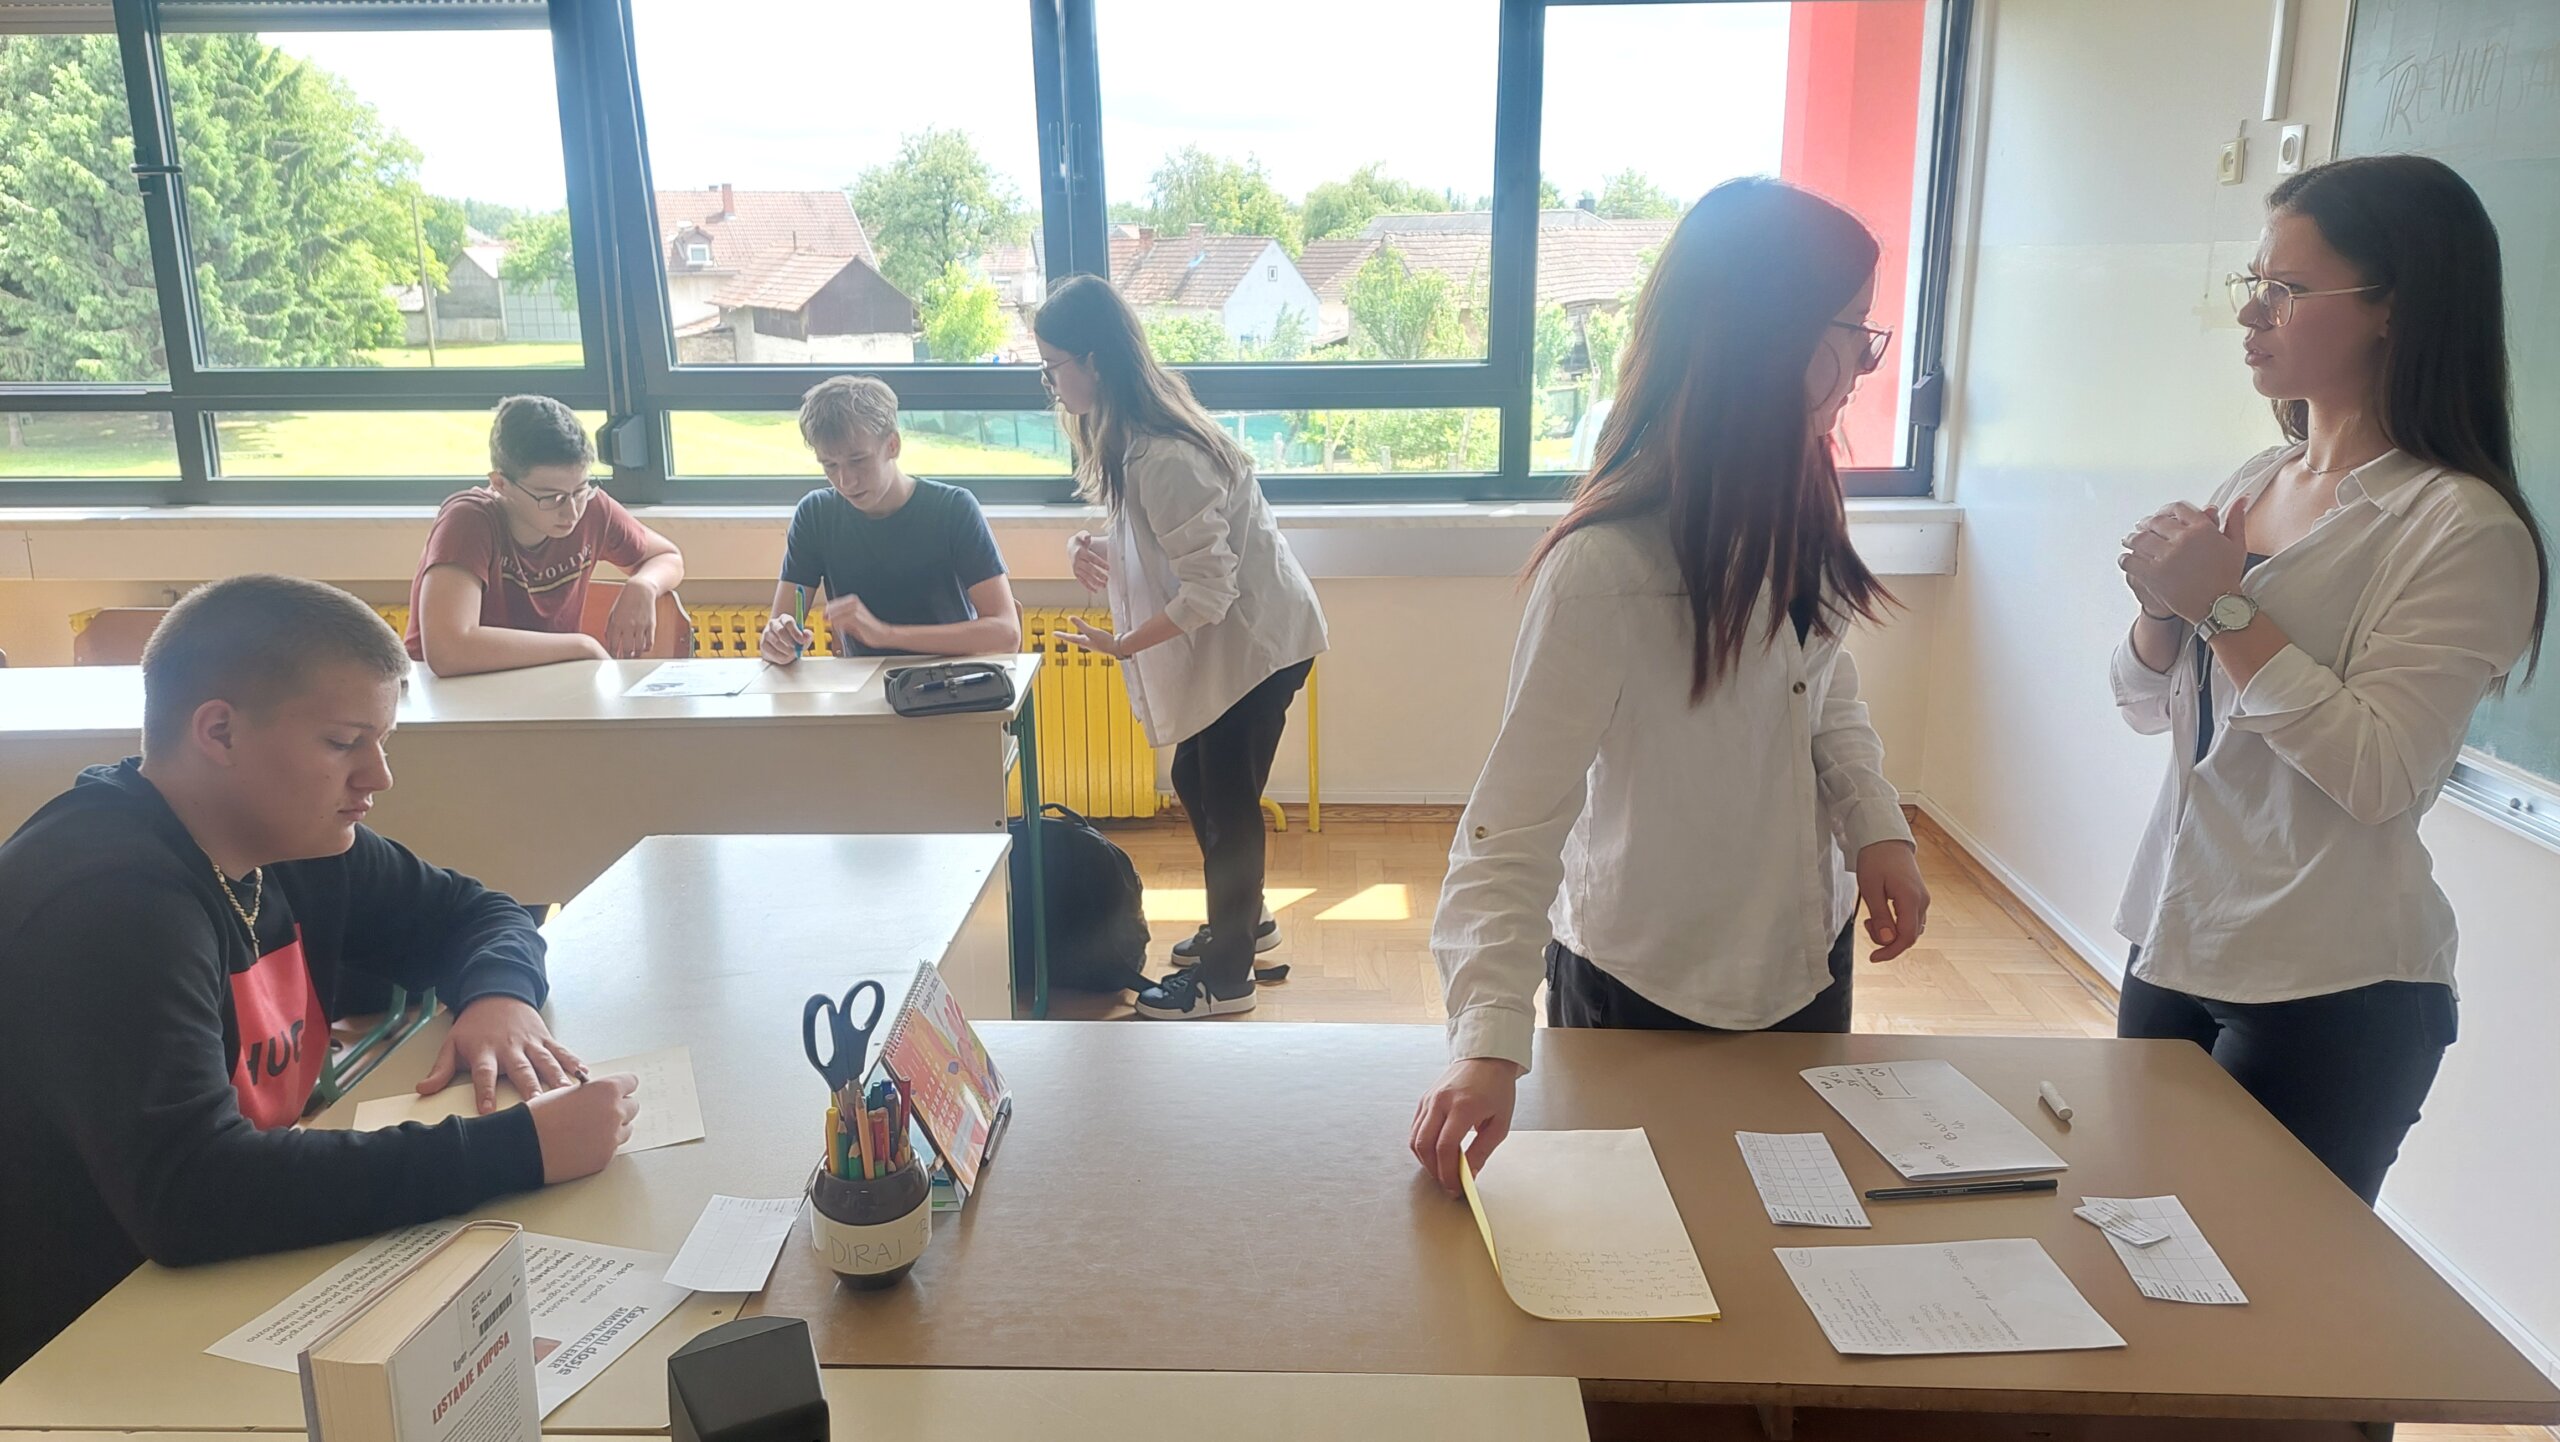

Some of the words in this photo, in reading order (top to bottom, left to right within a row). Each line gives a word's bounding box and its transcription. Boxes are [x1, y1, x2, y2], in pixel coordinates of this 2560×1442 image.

[829, 1236, 901, 1267] DIRAJ
[592, 1307, 629, 1332] SIMON
[592, 1305, 650, 1346] Kazneni
[547, 1332, 598, 1369] KELLEHER
[555, 1345, 597, 1377] dosje
[432, 1368, 475, 1425] LISTANJE
[476, 1331, 510, 1377] KUPUSA
